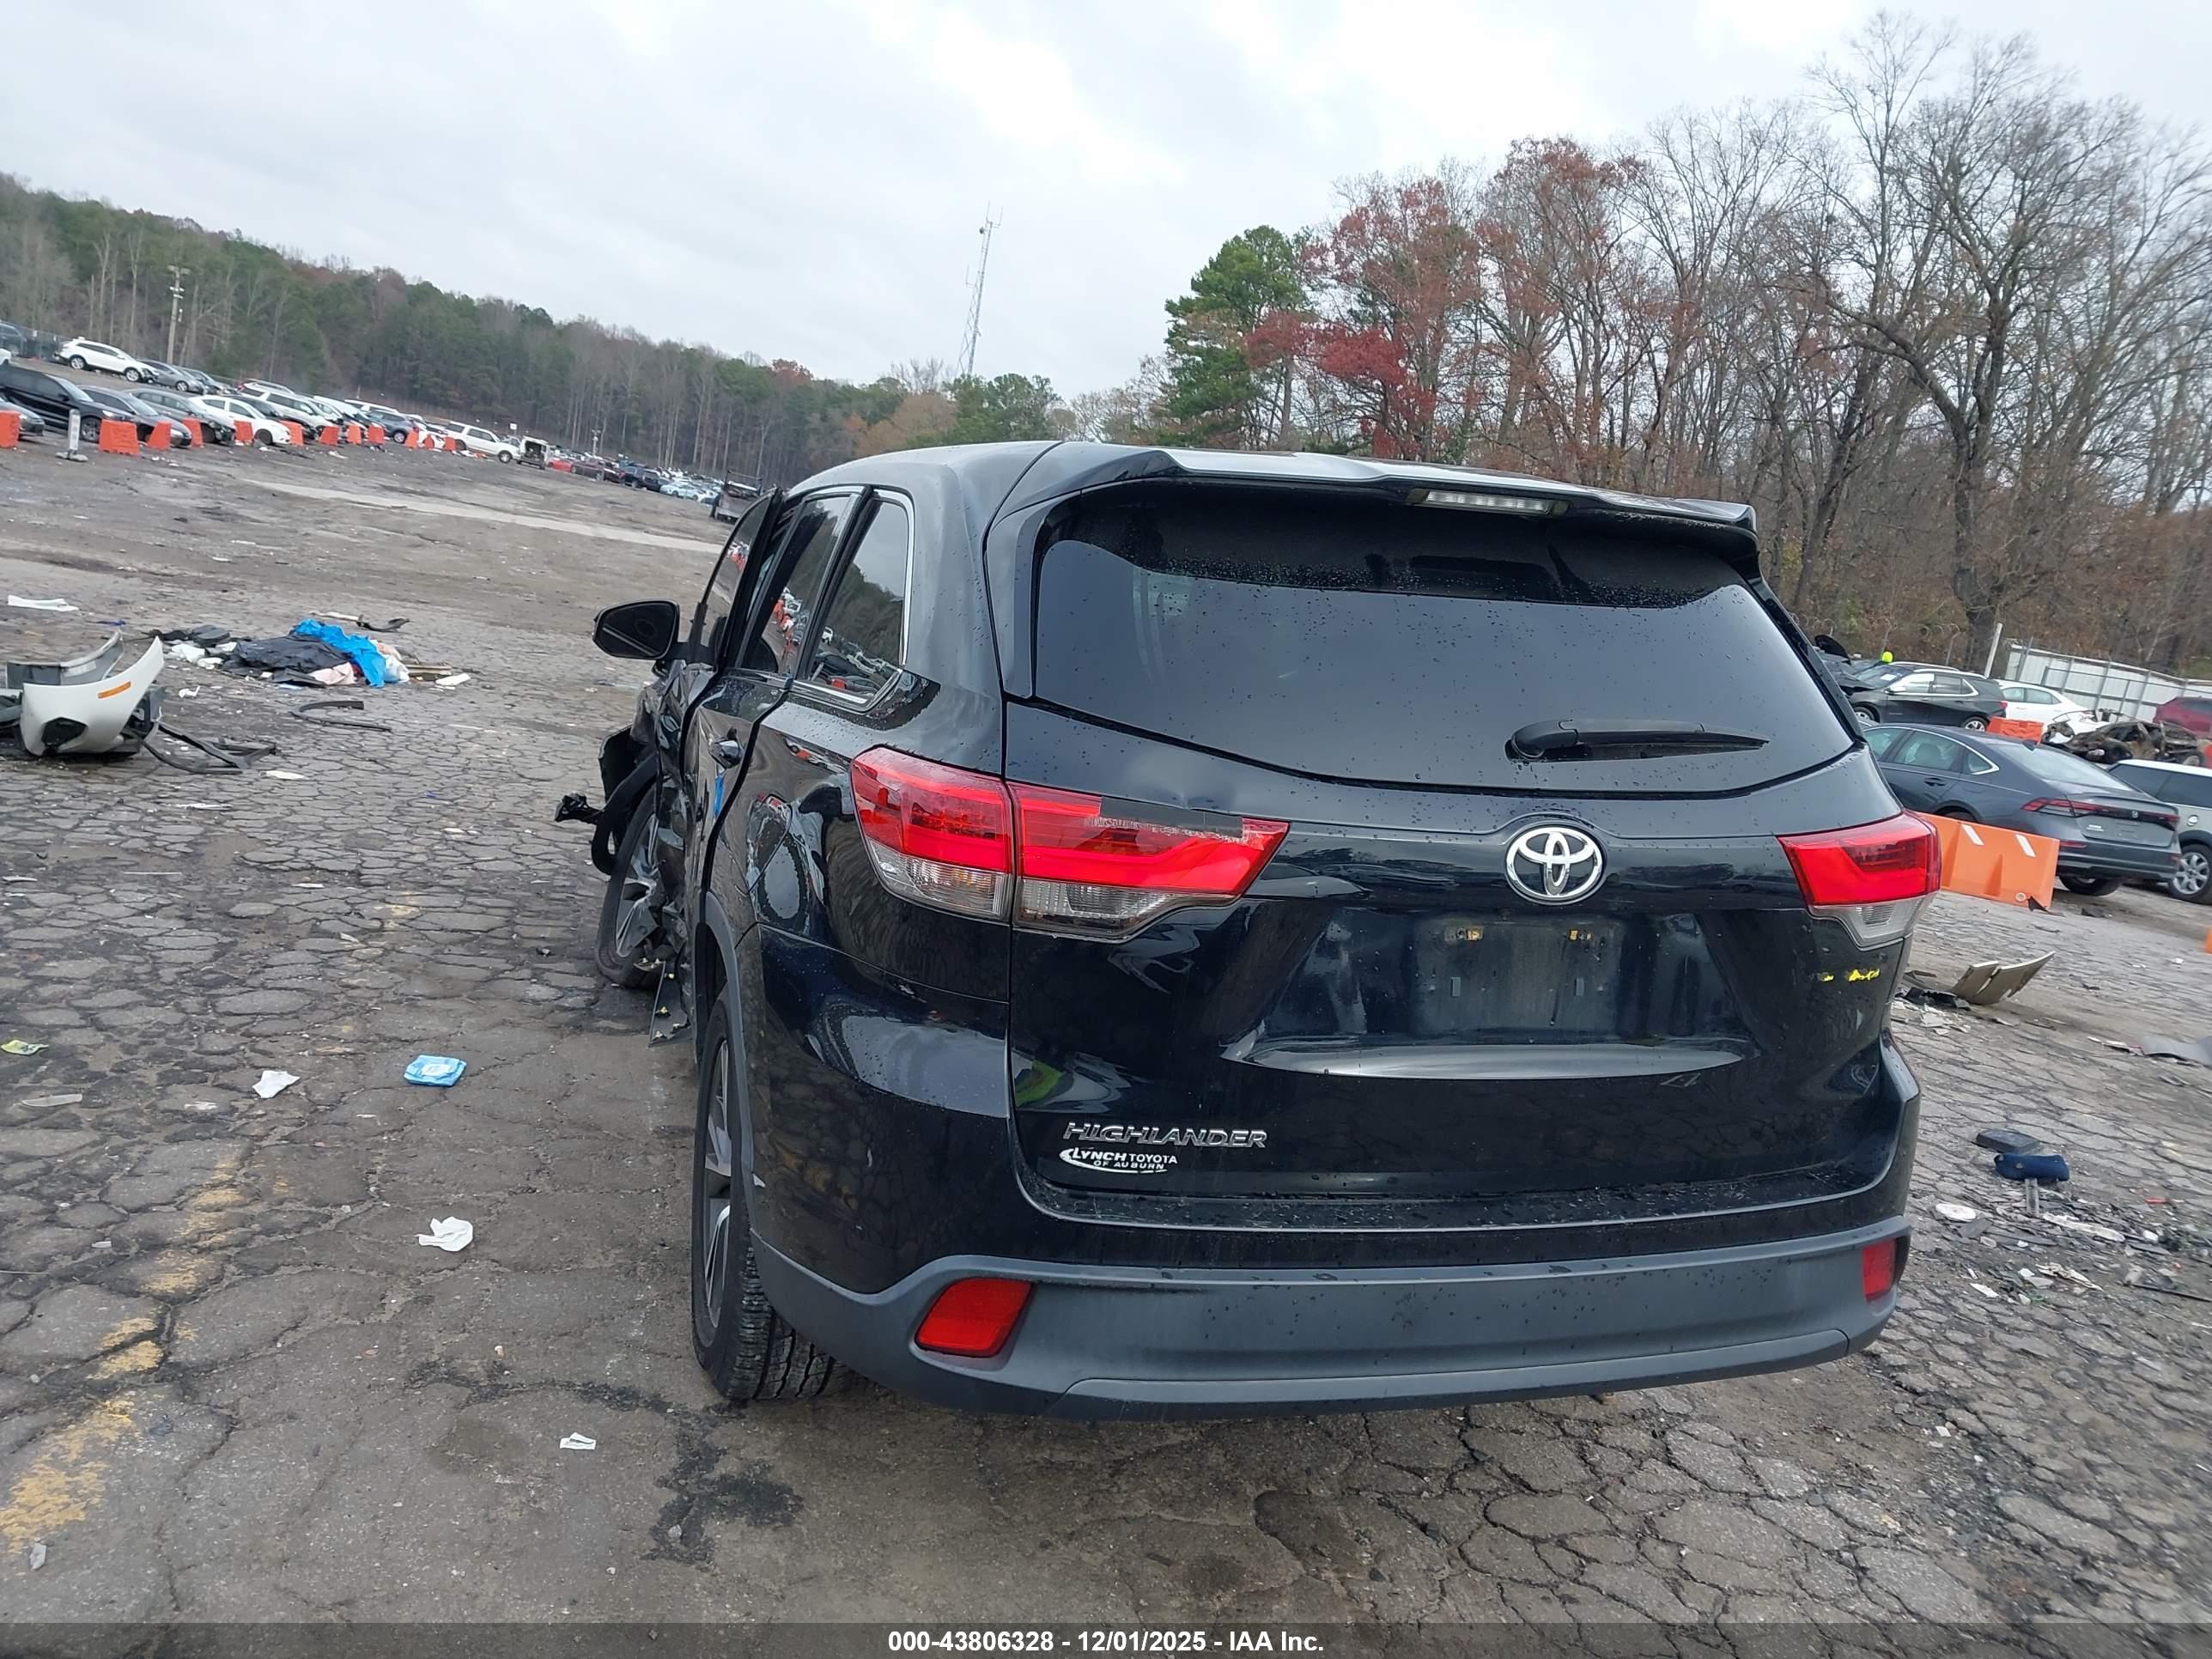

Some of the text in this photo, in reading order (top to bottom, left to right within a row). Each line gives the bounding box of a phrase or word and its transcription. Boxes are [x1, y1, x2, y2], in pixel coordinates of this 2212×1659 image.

[1062, 1121, 1268, 1148] HIGHLANDER
[1072, 1147, 1178, 1164] LYNCH TOYOTA
[1114, 1161, 1164, 1170] AUBURN
